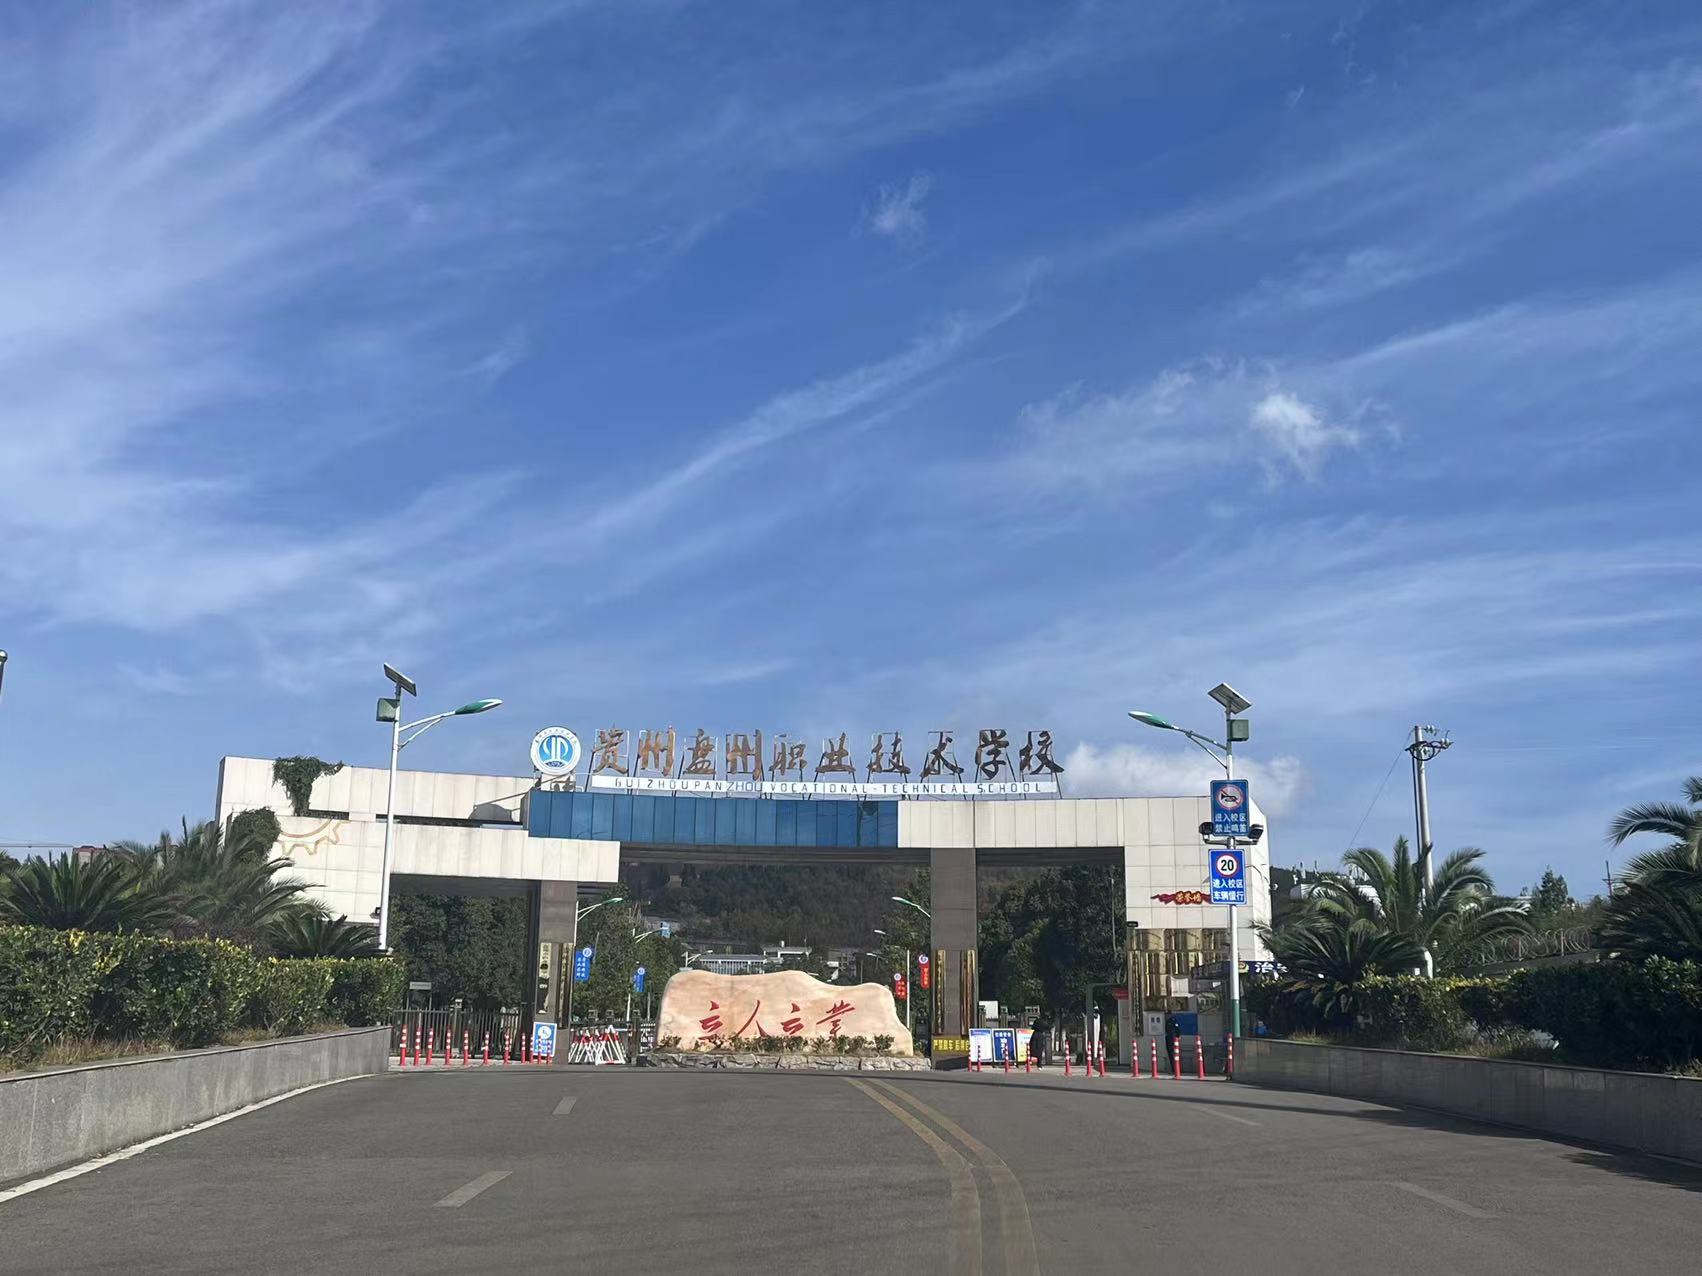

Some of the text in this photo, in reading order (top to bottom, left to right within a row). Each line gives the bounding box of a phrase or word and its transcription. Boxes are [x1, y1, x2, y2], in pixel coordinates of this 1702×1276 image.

[977, 782, 1042, 794] SCHOOL
[1214, 812, 1247, 822] 进入校区
[1215, 823, 1247, 833] 禁止鸣笛
[1220, 859, 1234, 871] 20
[1212, 878, 1244, 889] 进入校区
[1213, 890, 1245, 901] 车辆慢行
